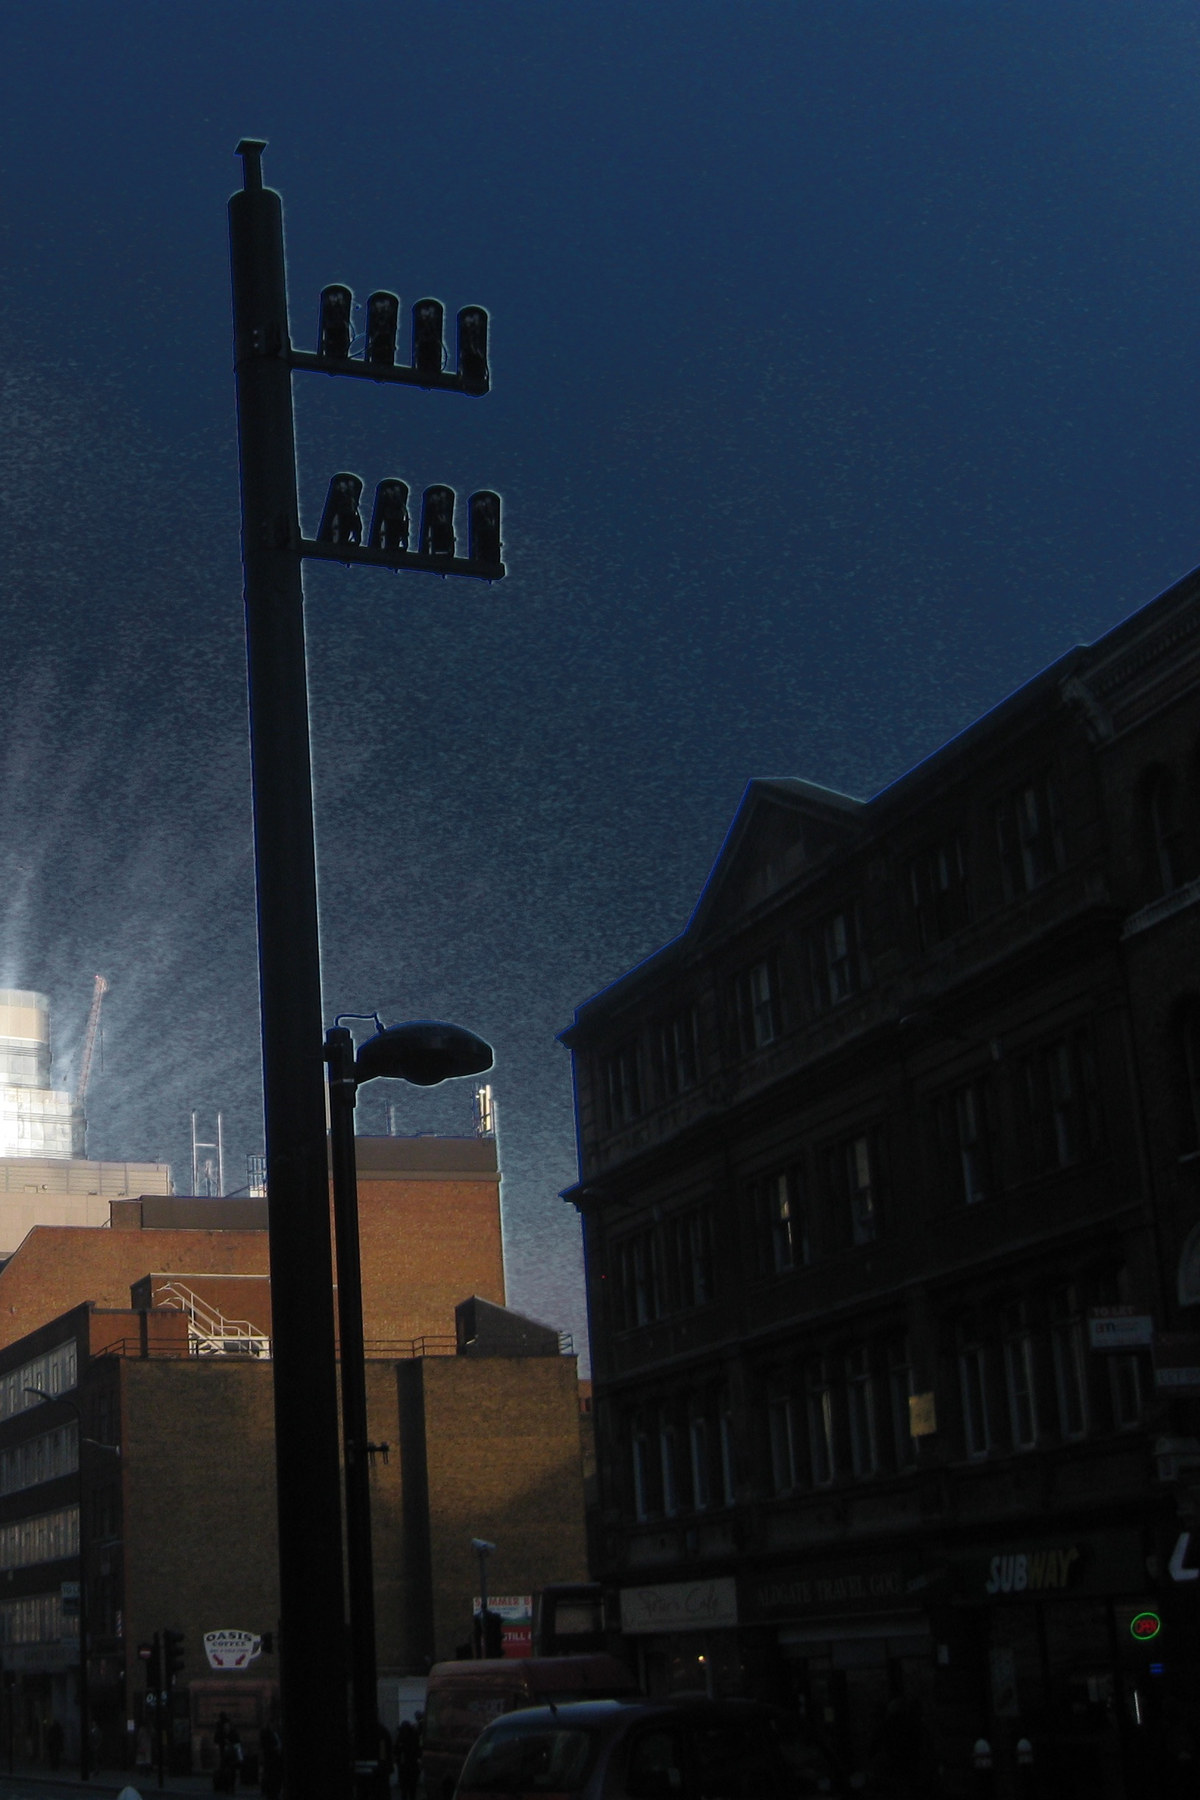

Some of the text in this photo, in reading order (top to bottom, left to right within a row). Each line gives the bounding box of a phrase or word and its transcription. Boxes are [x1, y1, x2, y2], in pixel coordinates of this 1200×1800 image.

[985, 1546, 1080, 1595] SUBWAY
[815, 1575, 866, 1601] TRAVEL
[206, 1632, 252, 1642] OASIS
